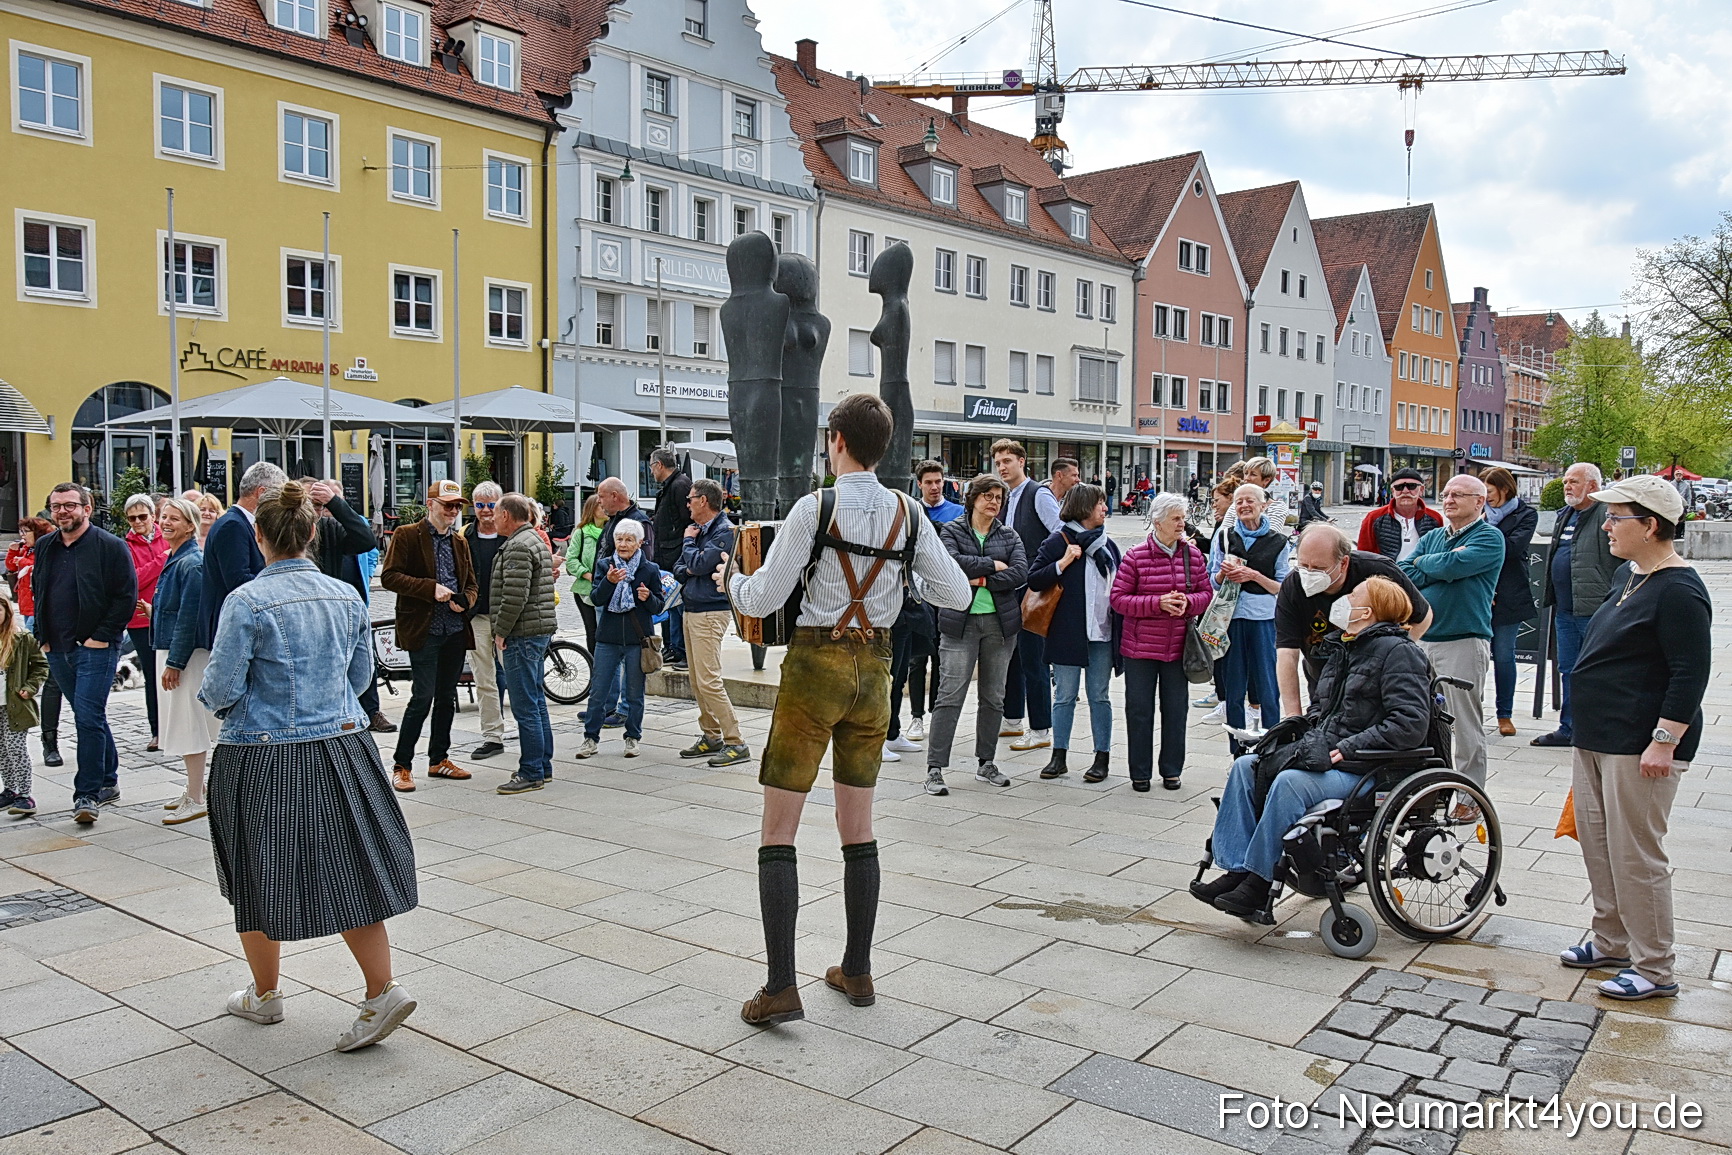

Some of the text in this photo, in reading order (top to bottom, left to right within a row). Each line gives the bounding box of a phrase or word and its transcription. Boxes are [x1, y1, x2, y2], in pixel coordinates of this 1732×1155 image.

[650, 256, 731, 284] BRILLEN WE
[217, 347, 267, 370] CAFÉ
[270, 358, 289, 371] AM
[642, 382, 729, 399] RÄTER IMMOBILIEN
[967, 398, 1017, 422] frühauf
[530, 443, 539, 451] 24
